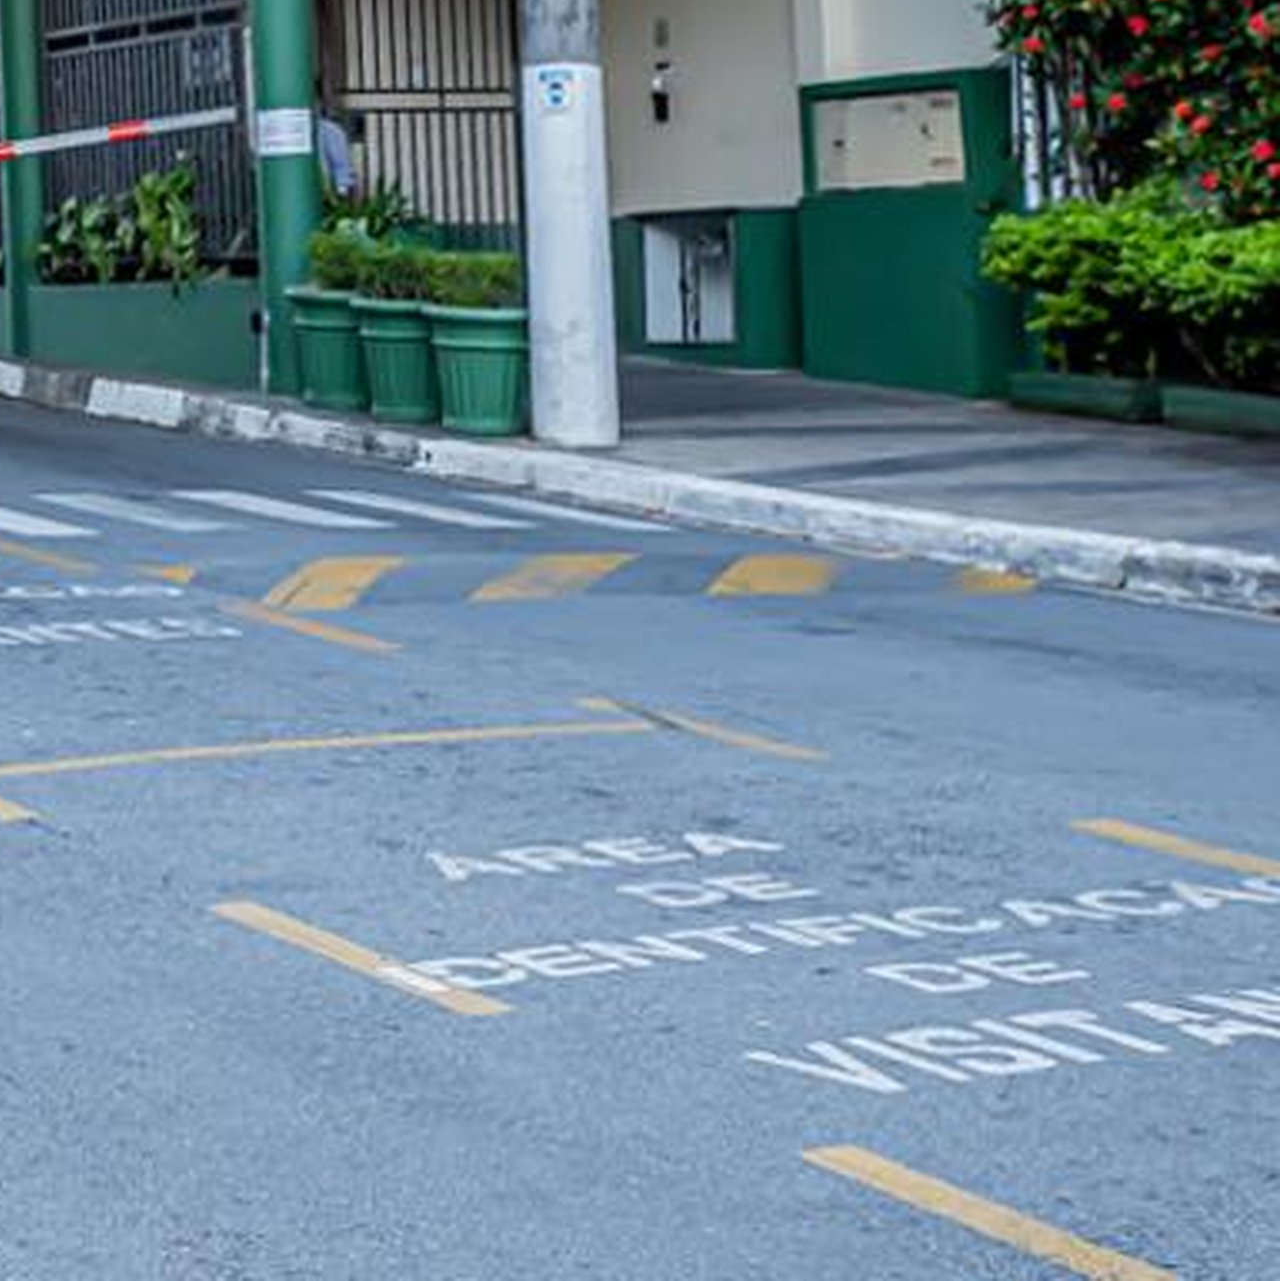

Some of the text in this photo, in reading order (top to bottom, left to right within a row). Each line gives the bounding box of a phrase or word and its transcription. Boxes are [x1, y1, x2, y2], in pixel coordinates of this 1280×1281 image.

[426, 830, 785, 883] AREA
[616, 871, 821, 908] DE
[862, 949, 1093, 995] DE
